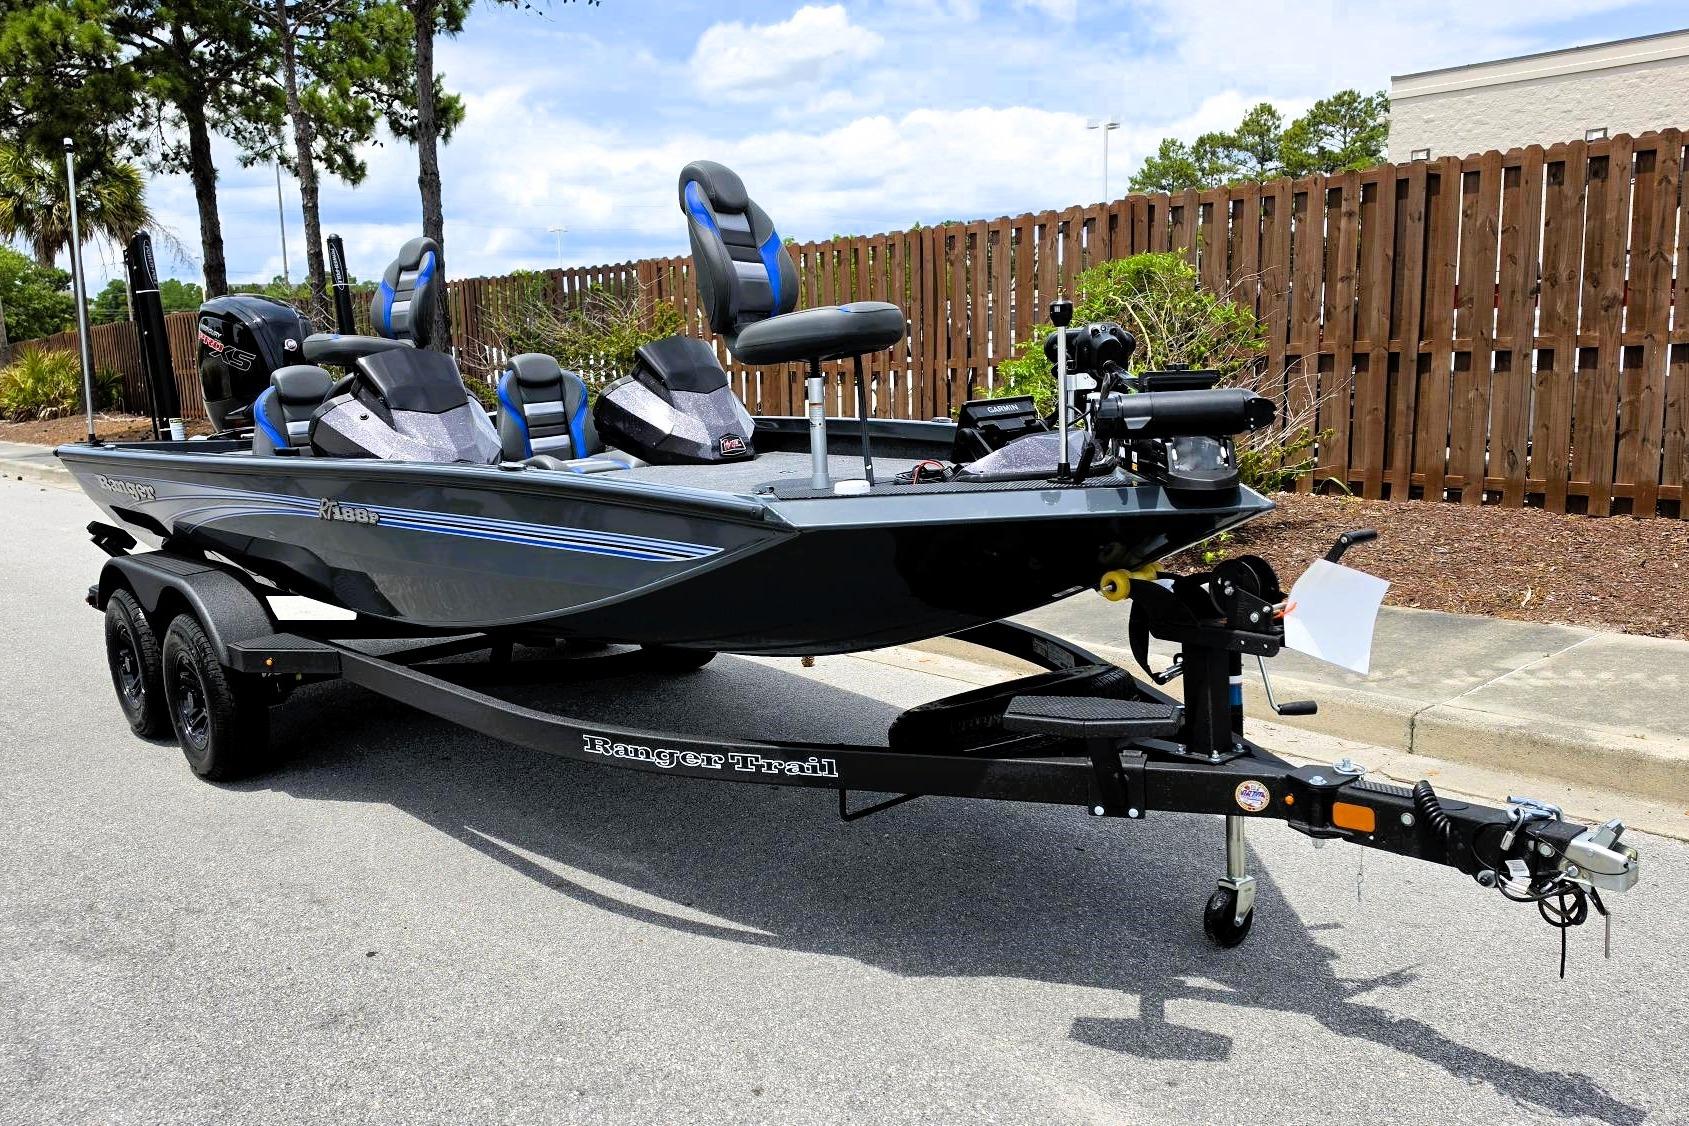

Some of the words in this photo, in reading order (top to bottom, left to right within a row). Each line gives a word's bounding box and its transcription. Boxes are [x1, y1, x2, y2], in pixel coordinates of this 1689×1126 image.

[987, 404, 1019, 413] GARMIN
[97, 474, 156, 501] Ranger
[583, 734, 724, 769] Ranger
[728, 752, 839, 778] Trail
